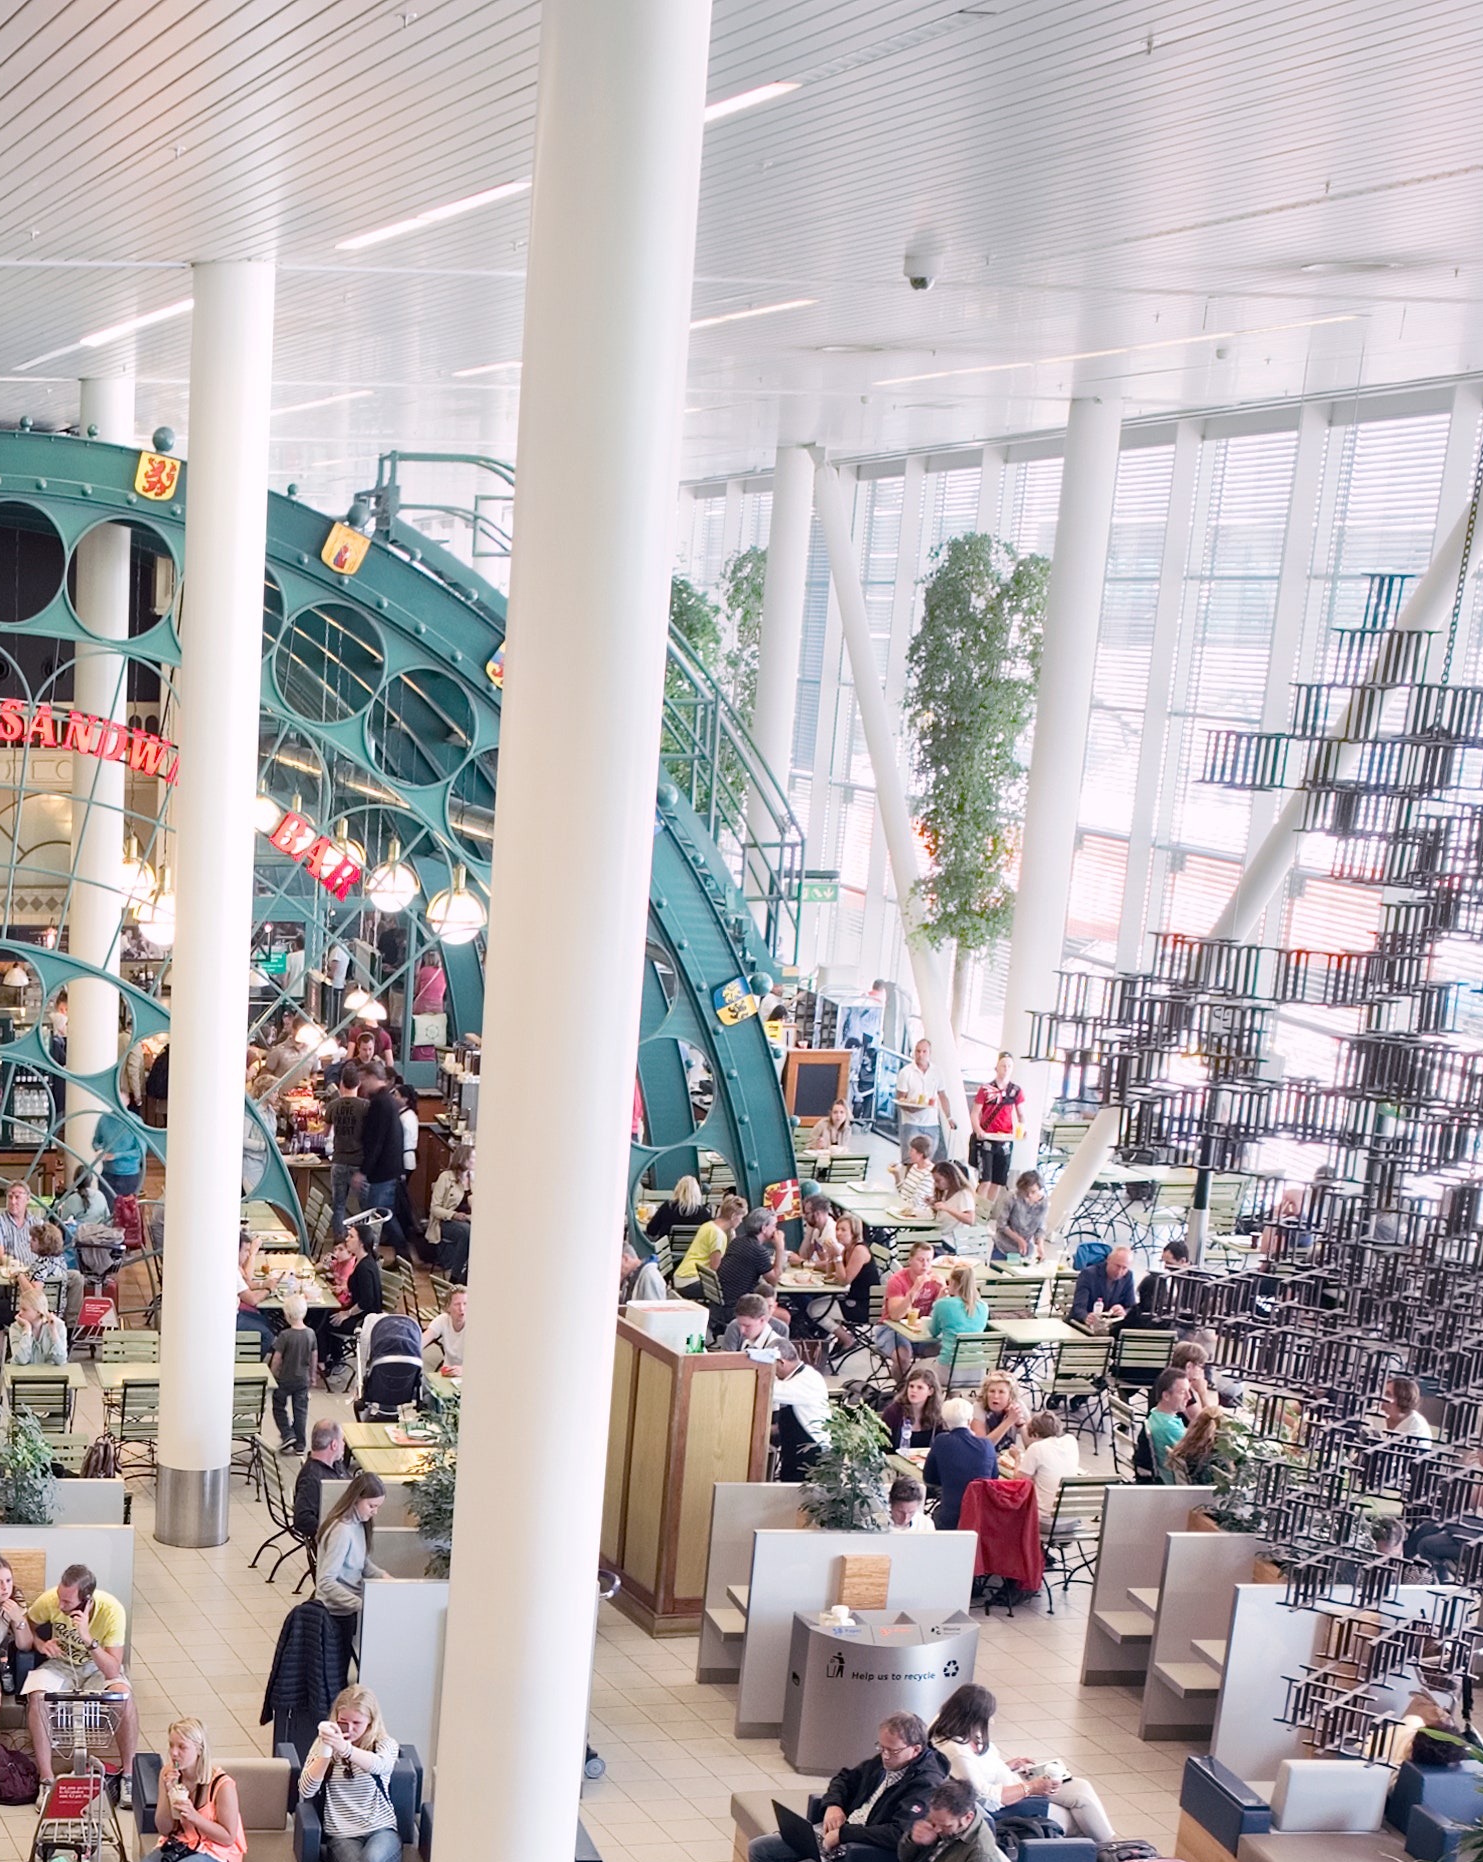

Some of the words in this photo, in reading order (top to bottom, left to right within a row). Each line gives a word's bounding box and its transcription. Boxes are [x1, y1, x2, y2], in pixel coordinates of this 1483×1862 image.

[269, 811, 362, 902] BAR
[852, 1671, 875, 1681] Help
[904, 1672, 936, 1682] recycle
